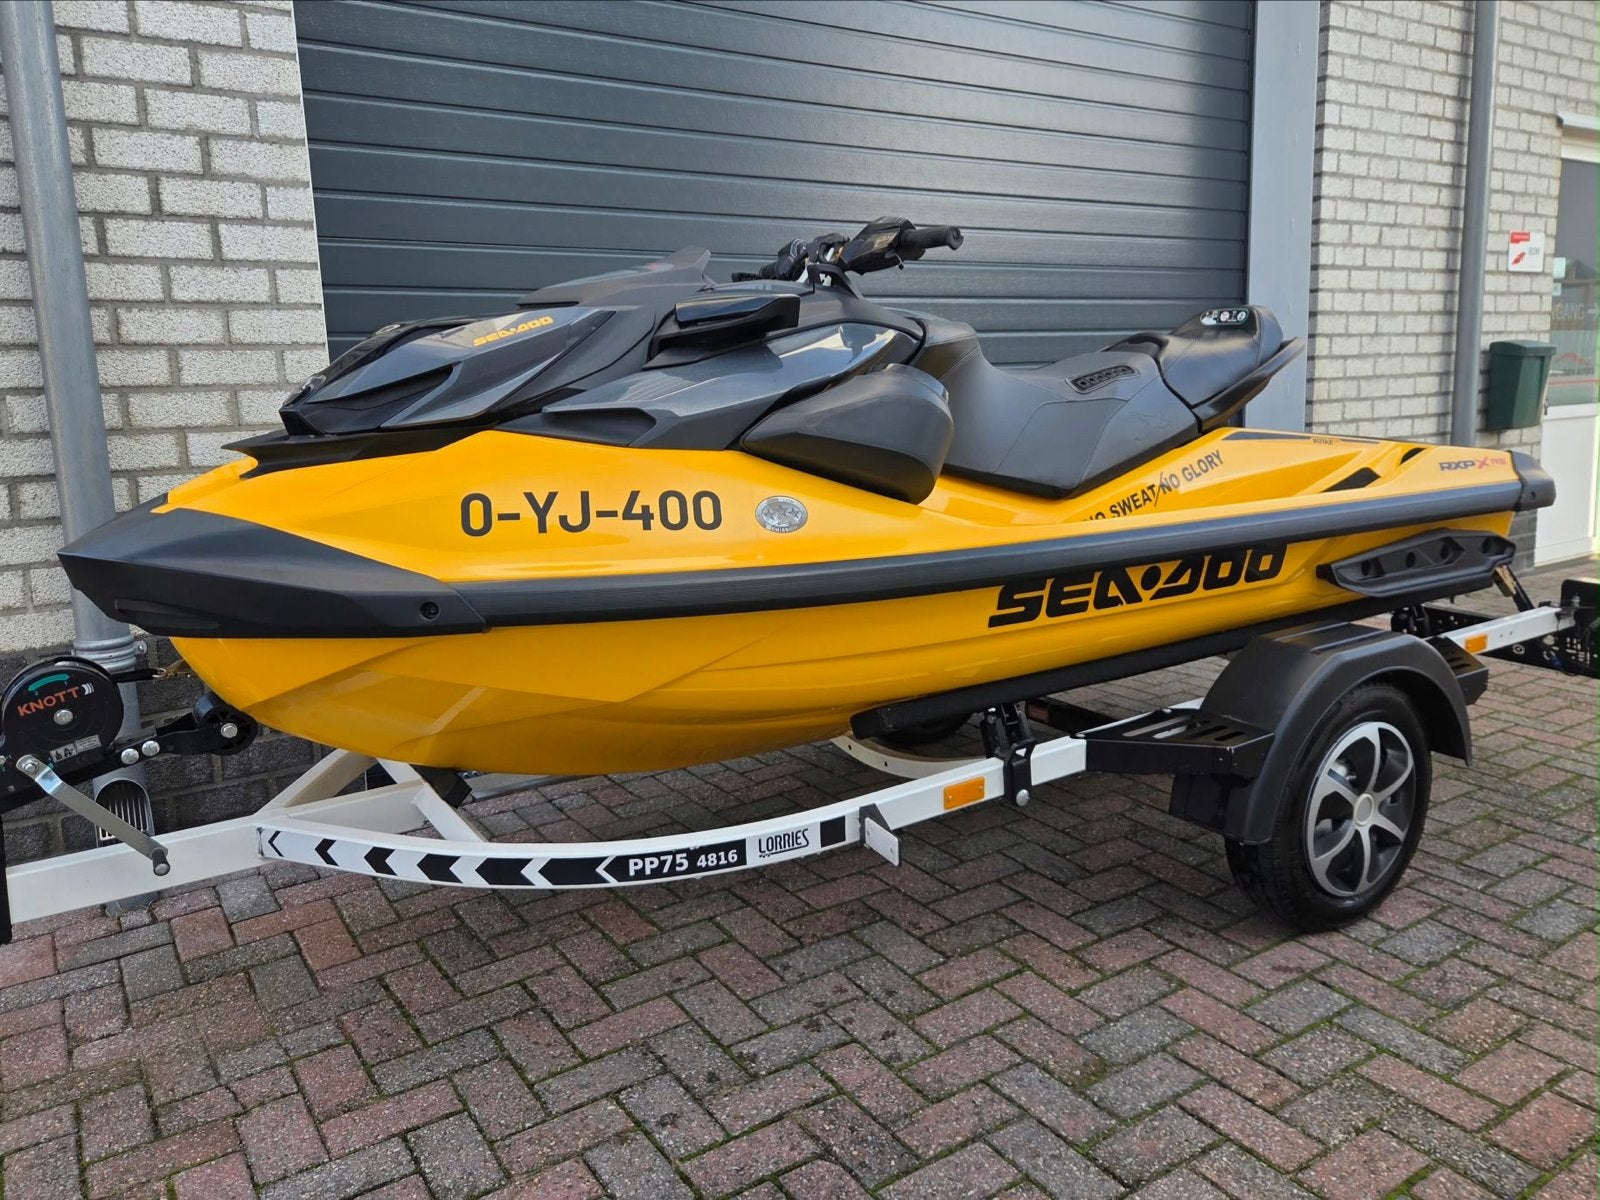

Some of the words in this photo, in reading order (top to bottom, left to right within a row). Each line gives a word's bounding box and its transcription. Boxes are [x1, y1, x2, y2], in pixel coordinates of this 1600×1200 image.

[1182, 449, 1224, 482] GLORY
[17, 686, 80, 717] KNOTT
[758, 828, 810, 854] LORRIES
[629, 854, 690, 877] PP75
[696, 849, 738, 868] 4816
